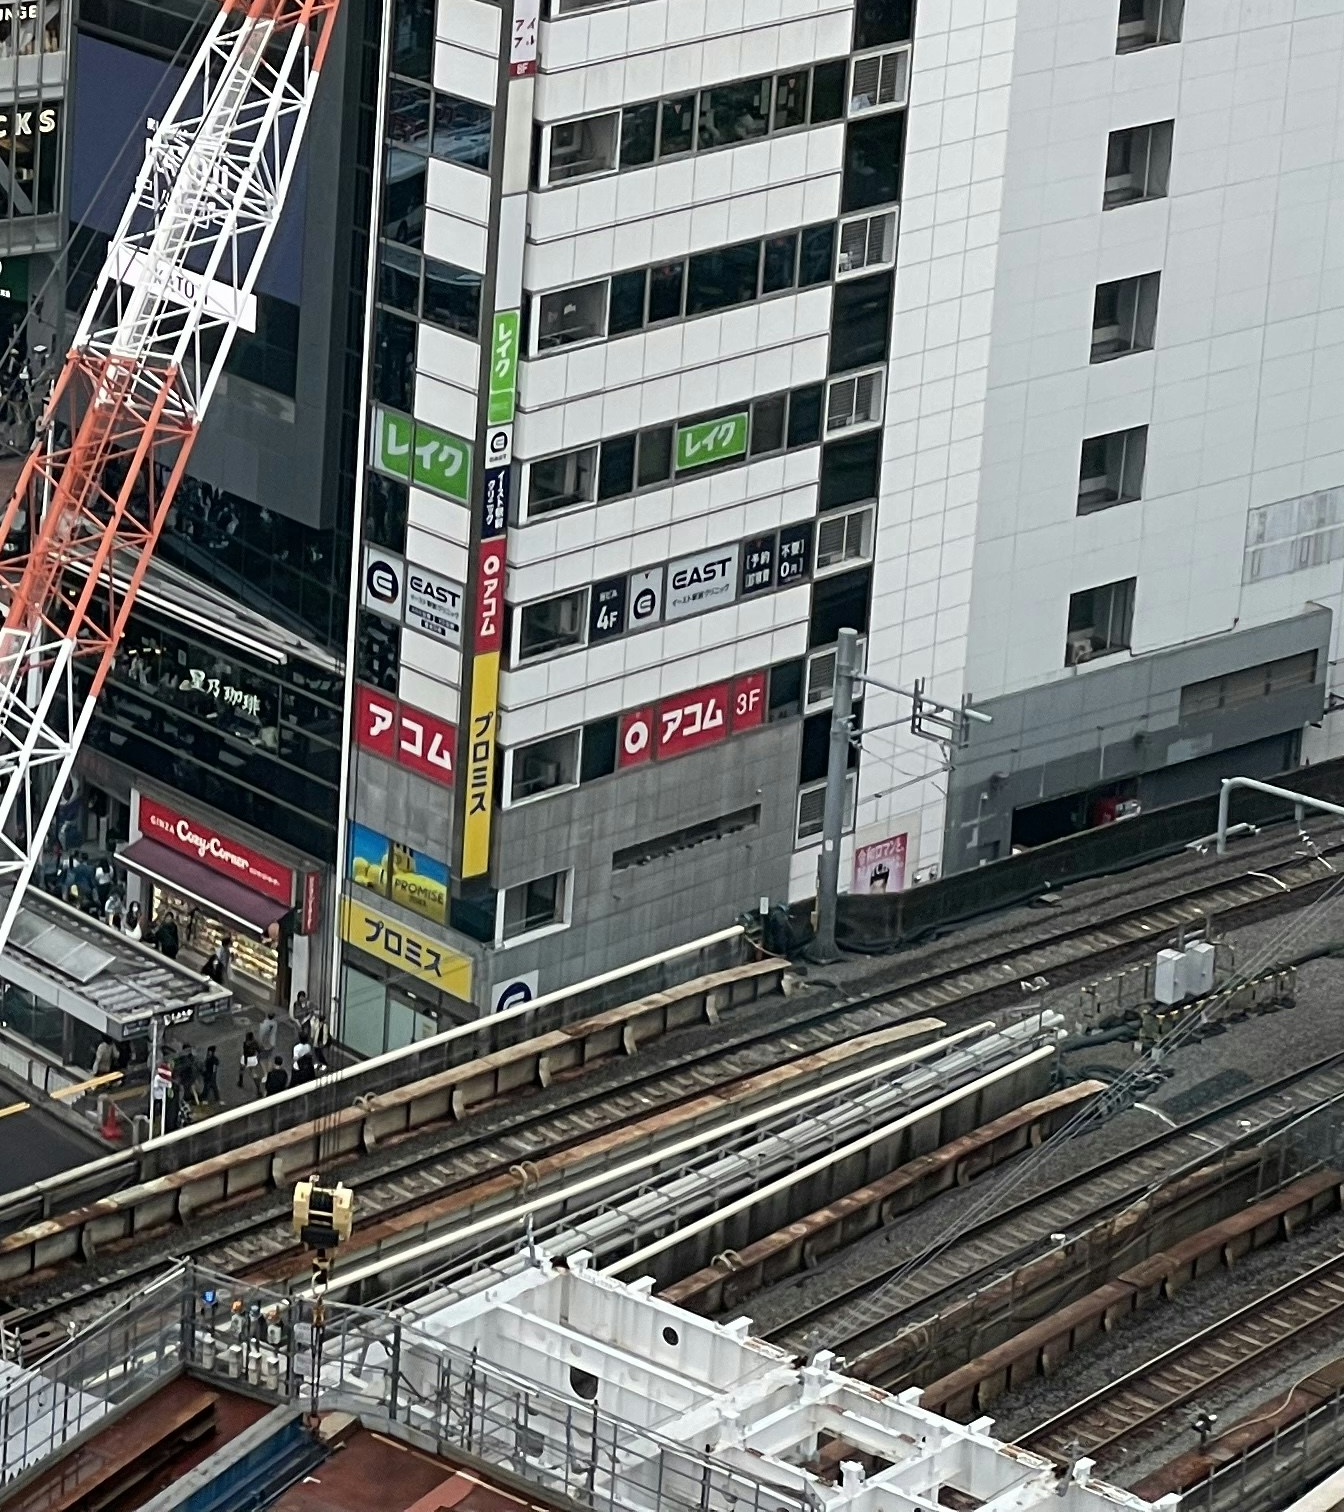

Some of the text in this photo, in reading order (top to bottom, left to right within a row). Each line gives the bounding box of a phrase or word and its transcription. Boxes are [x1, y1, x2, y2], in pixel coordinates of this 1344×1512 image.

[494, 322, 513, 379] レイク
[386, 422, 463, 477] レイク
[684, 420, 736, 455] レイク
[409, 574, 461, 609] EAST
[672, 556, 733, 590] EAST
[480, 578, 499, 636] アコム
[596, 605, 618, 631] 4F
[367, 703, 453, 771] アコム
[662, 688, 761, 744] アコム 3F
[469, 710, 493, 815] プロミス
[394, 878, 444, 904] PROMISE
[364, 917, 442, 978] プロミス
